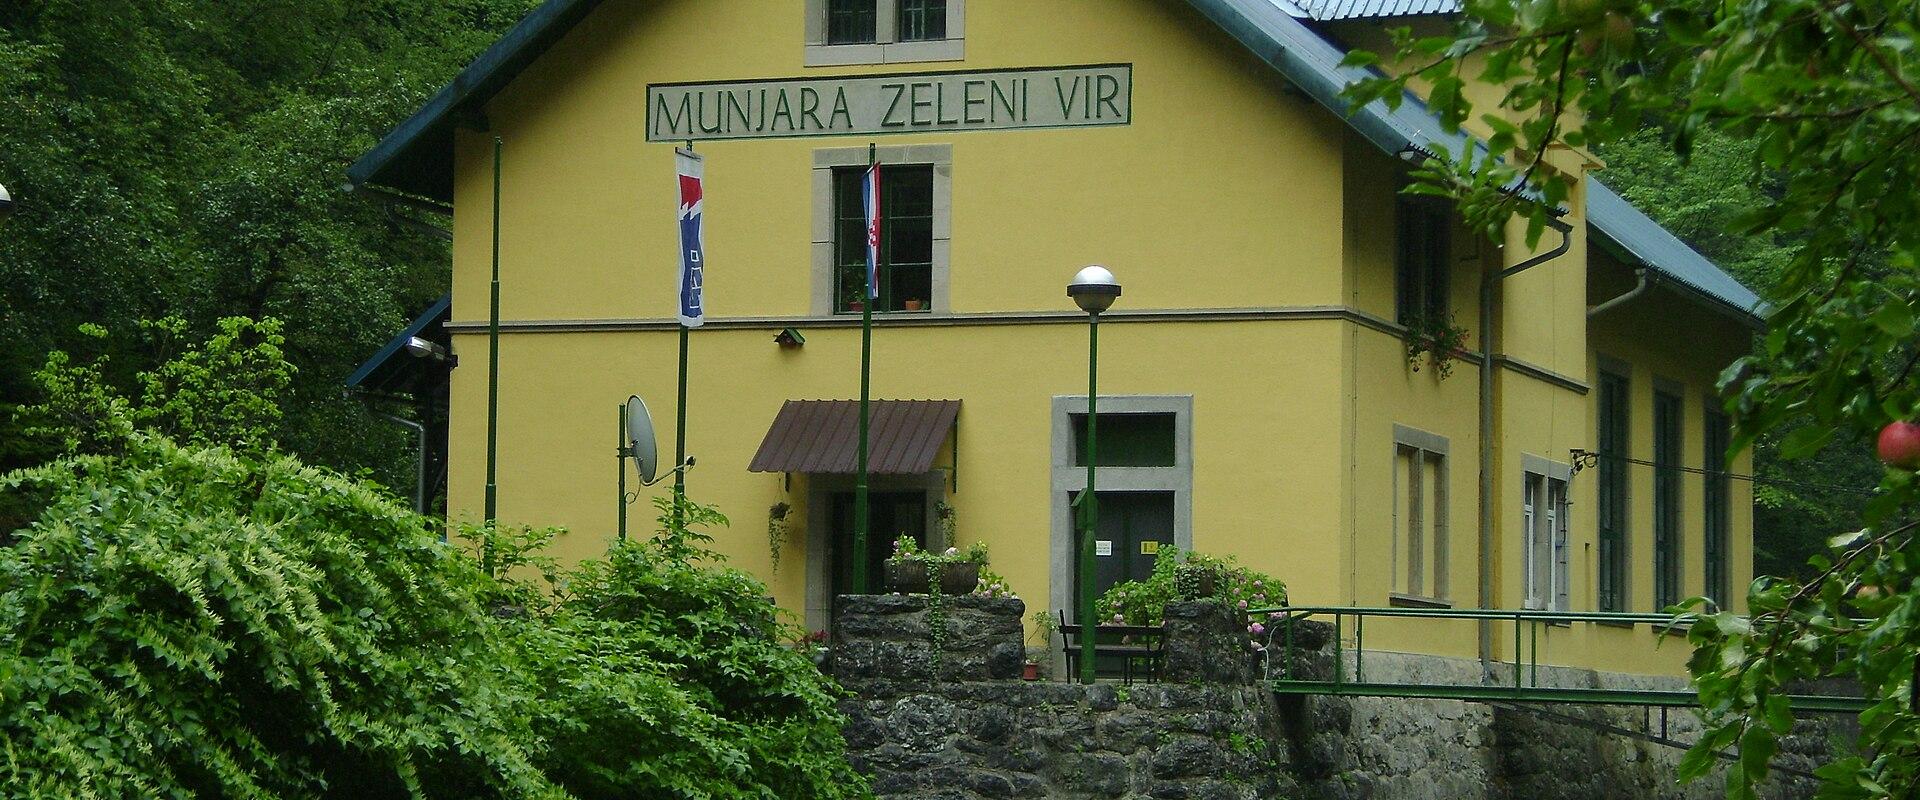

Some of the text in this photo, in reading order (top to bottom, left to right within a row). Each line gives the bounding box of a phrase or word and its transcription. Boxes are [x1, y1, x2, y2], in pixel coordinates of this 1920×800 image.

[655, 75, 1122, 135] MUNJARA ZELENI VIR
